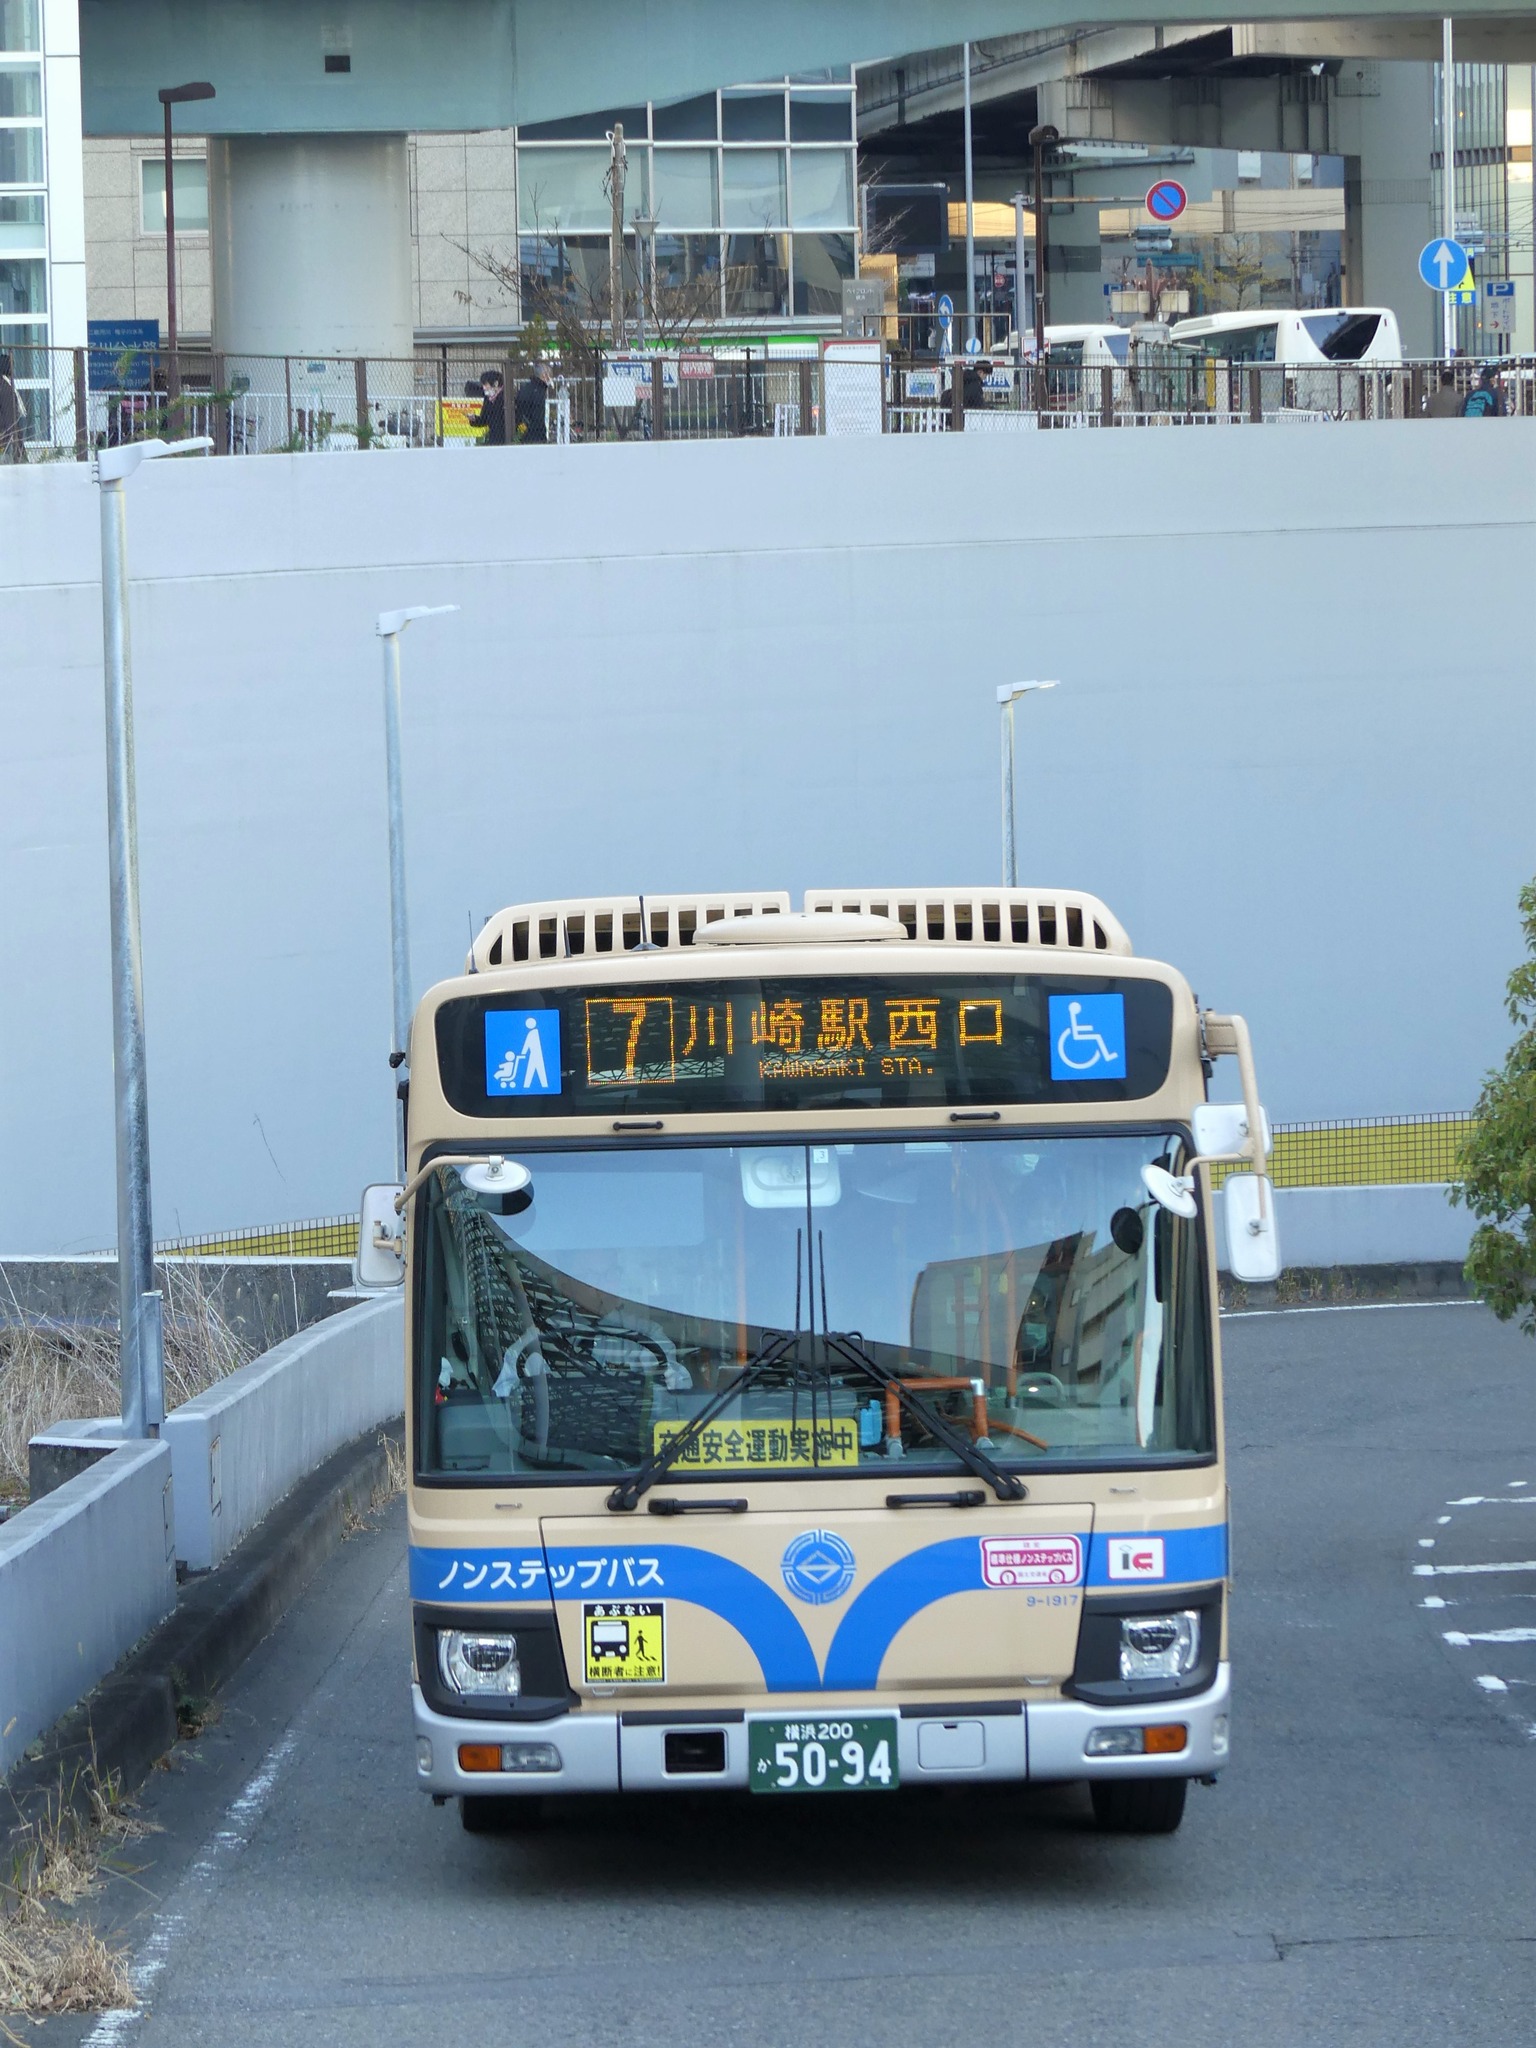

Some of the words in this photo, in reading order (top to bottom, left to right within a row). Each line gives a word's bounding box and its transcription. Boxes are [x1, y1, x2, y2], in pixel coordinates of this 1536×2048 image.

[1492, 283, 1508, 296] P
[613, 1002, 646, 1079] 7
[682, 998, 1002, 1056] 川崎駅西口
[759, 1058, 866, 1079] KAWASAKI
[881, 1057, 934, 1076] STA.
[438, 1557, 665, 1590] ノンステップバス
[1026, 1594, 1078, 1607] 9-1917
[593, 1604, 652, 1617] あぶない
[589, 1665, 660, 1677] 横断者に注意!
[757, 1758, 772, 1774] か
[775, 1740, 892, 1787] 50-94
